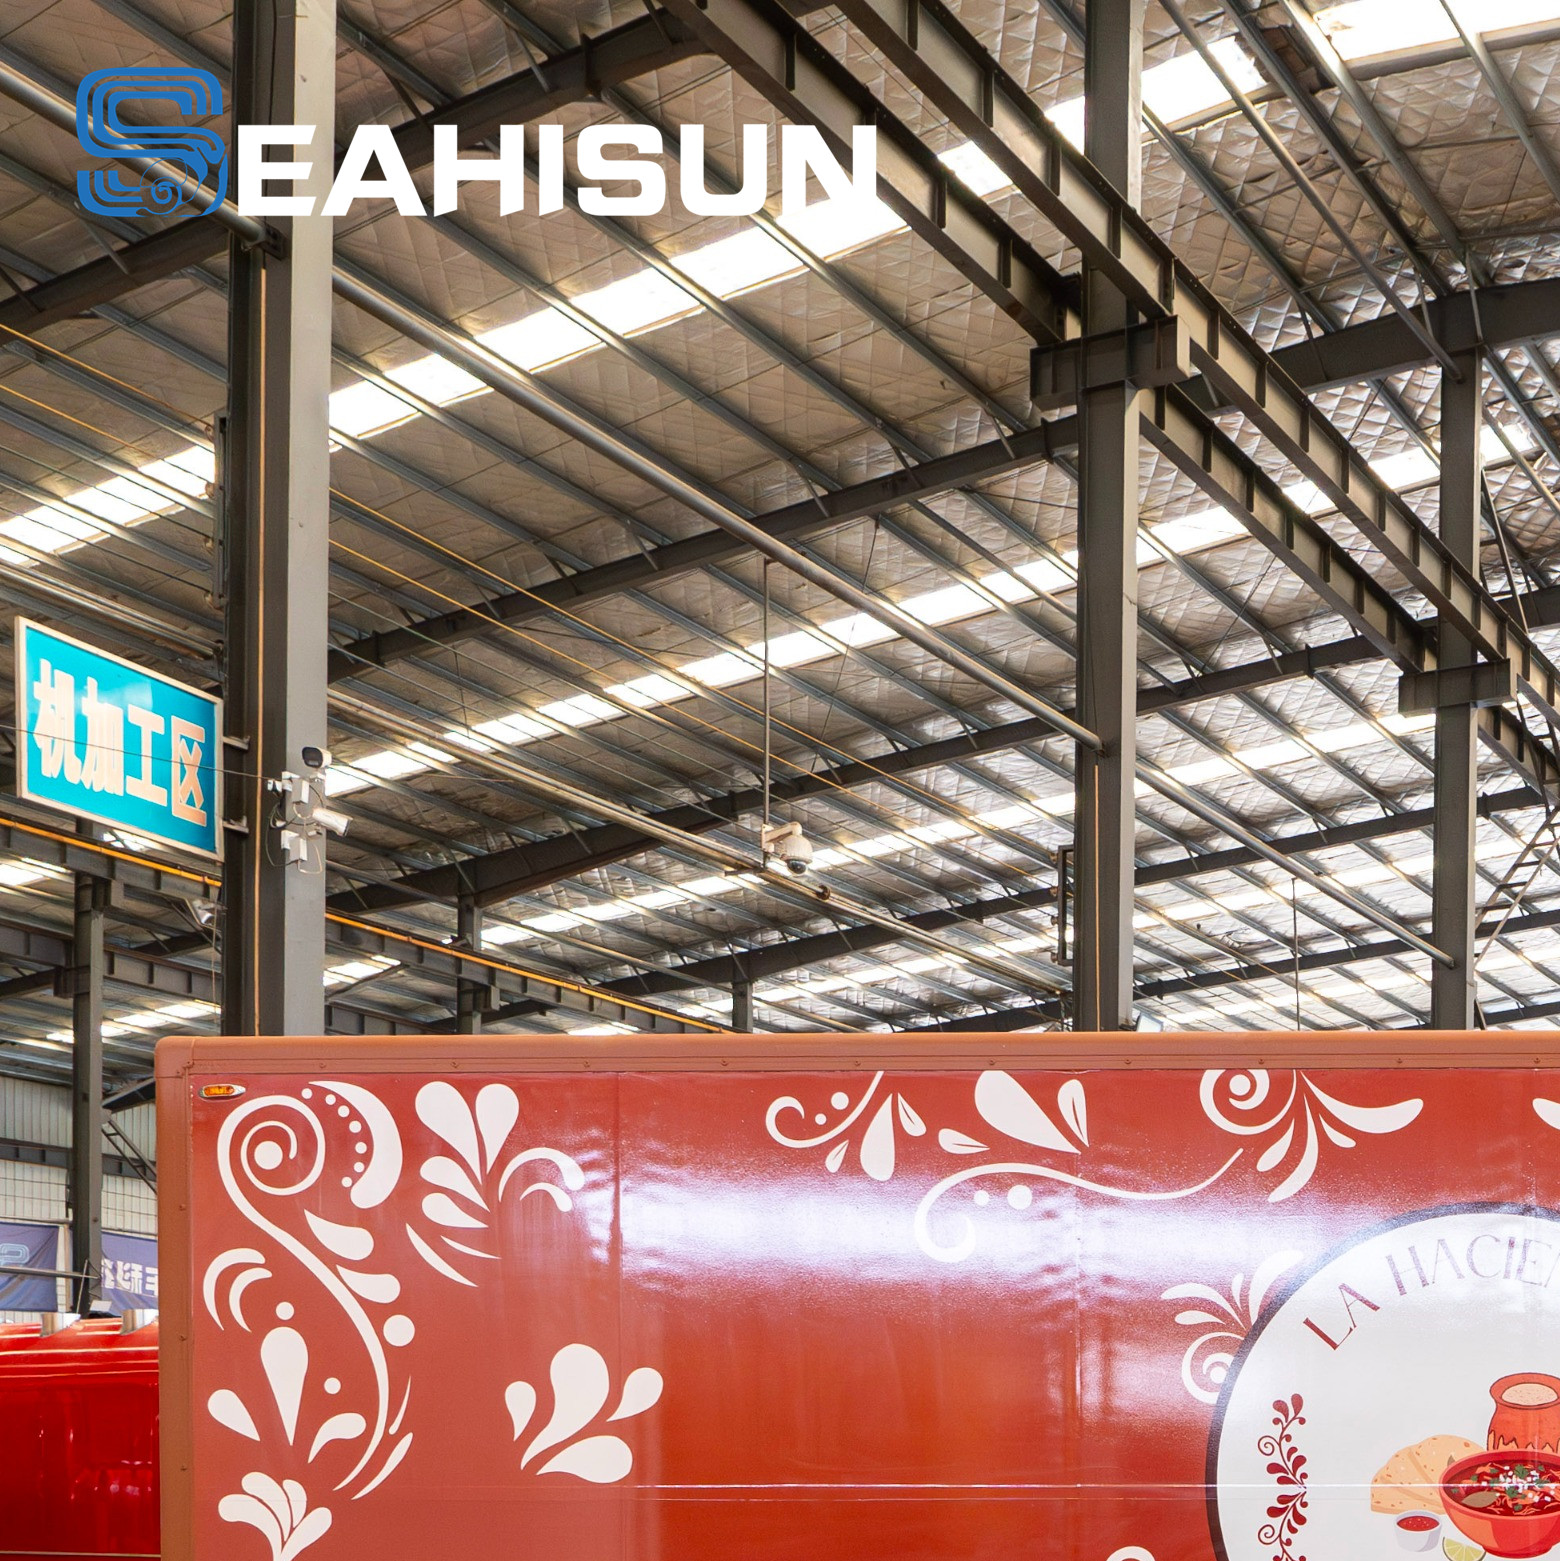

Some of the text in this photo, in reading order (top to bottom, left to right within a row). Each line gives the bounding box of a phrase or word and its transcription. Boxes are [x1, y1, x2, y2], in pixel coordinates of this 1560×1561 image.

[33, 658, 207, 827] 机加工区
[1303, 1282, 1381, 1350] LA
